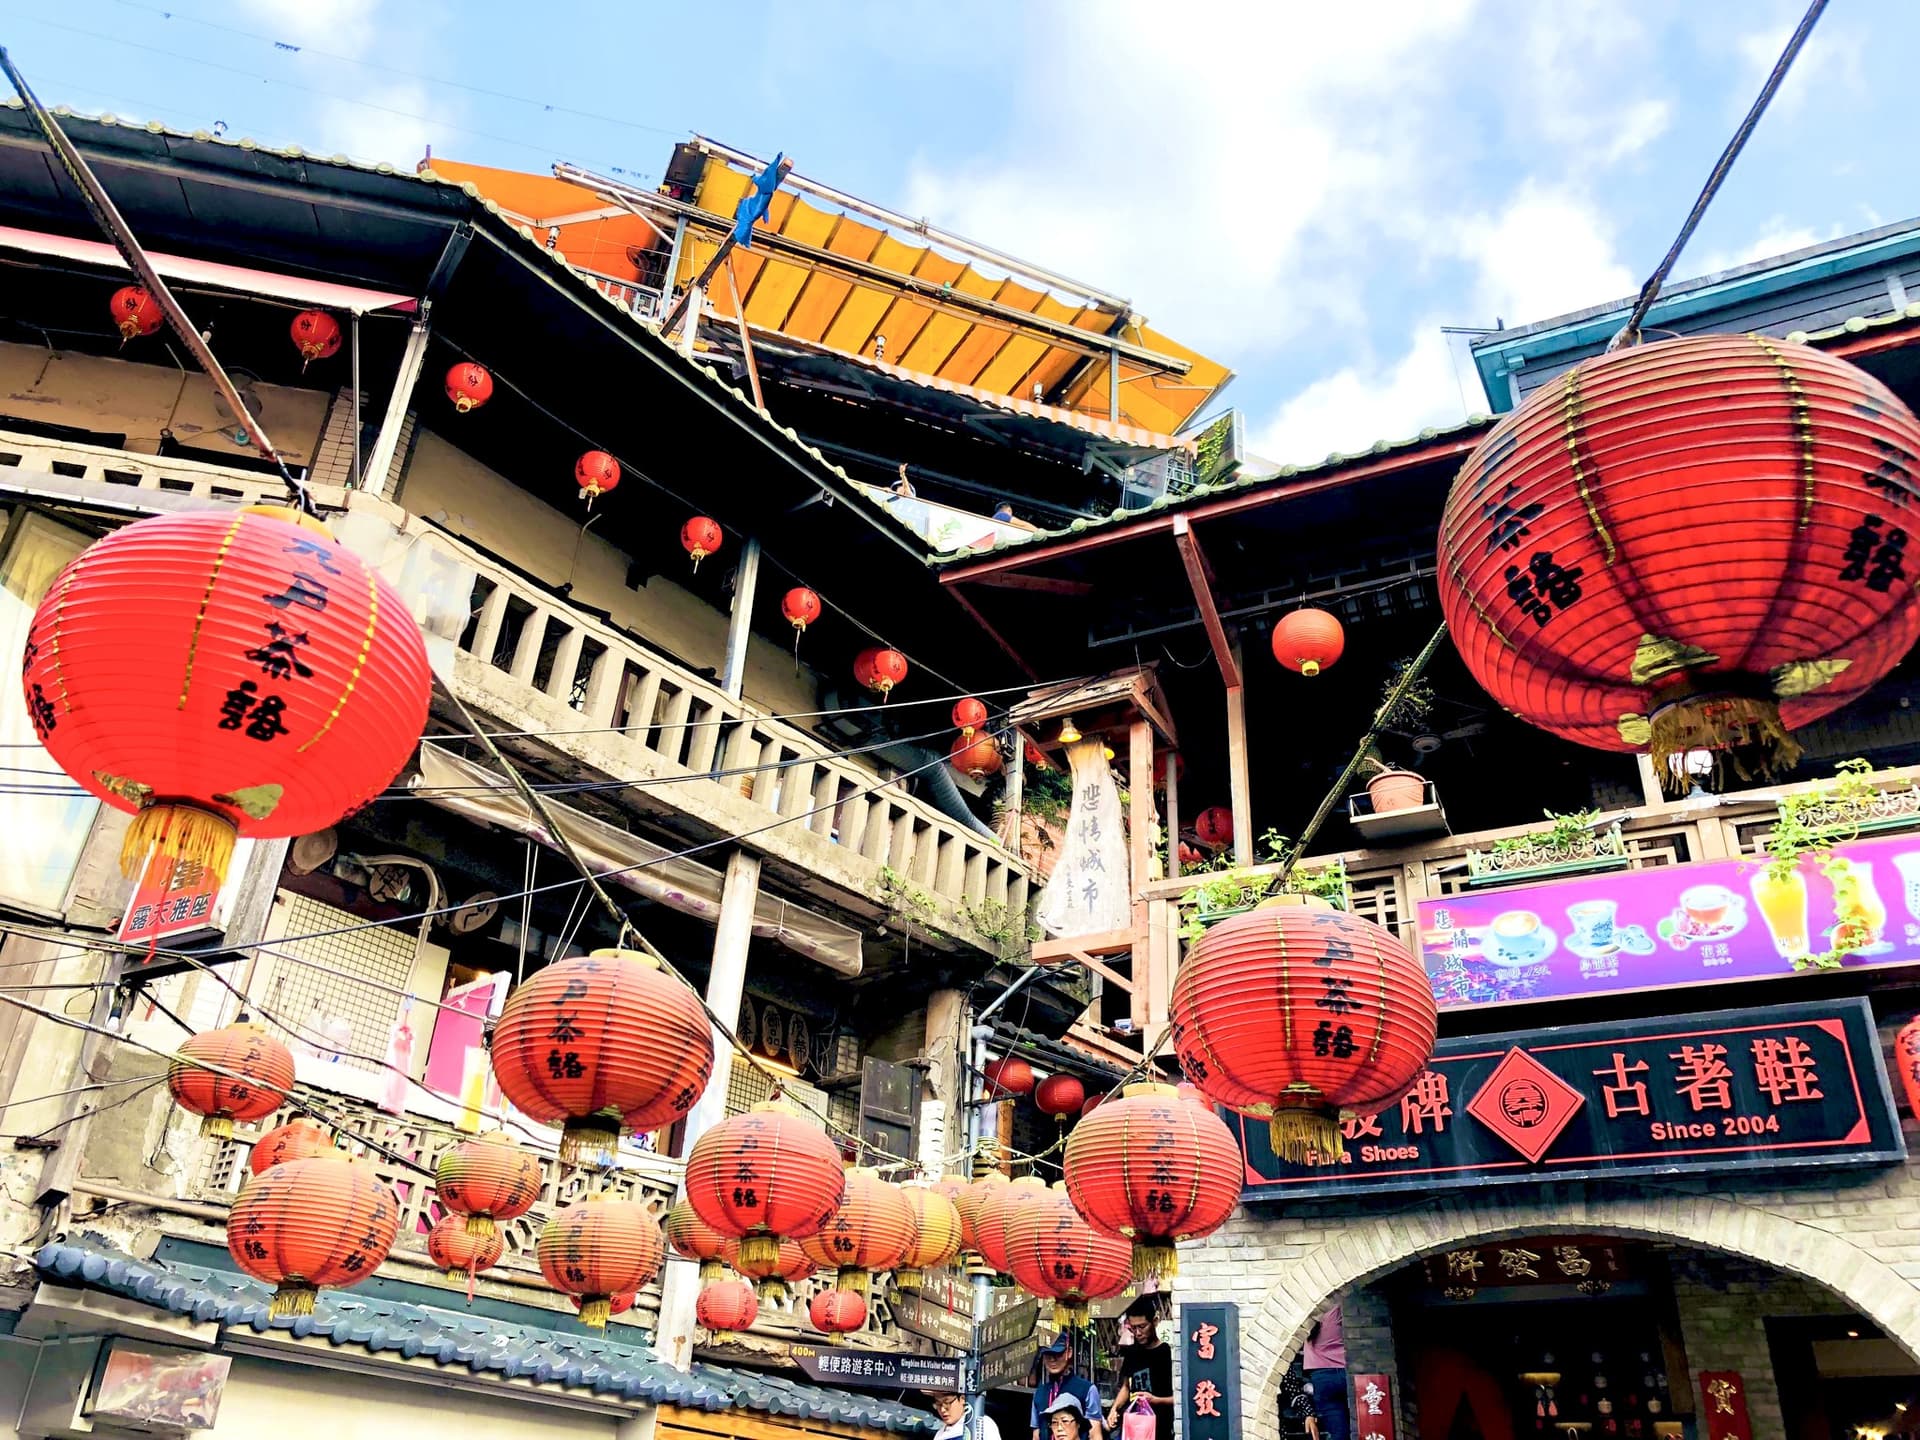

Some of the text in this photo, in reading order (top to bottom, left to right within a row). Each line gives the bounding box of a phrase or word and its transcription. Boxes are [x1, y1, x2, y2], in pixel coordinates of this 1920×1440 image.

[1078, 783, 1106, 914] 悲情城市
[128, 893, 212, 931] 露天雅座
[1434, 909, 1472, 998] 悲情城市
[1593, 1037, 1824, 1118] 古著鞋
[1651, 1114, 1780, 1141] Since 2004
[1361, 1145, 1419, 1163] Shoes
[818, 1355, 896, 1377] 輕便路遊客中心
